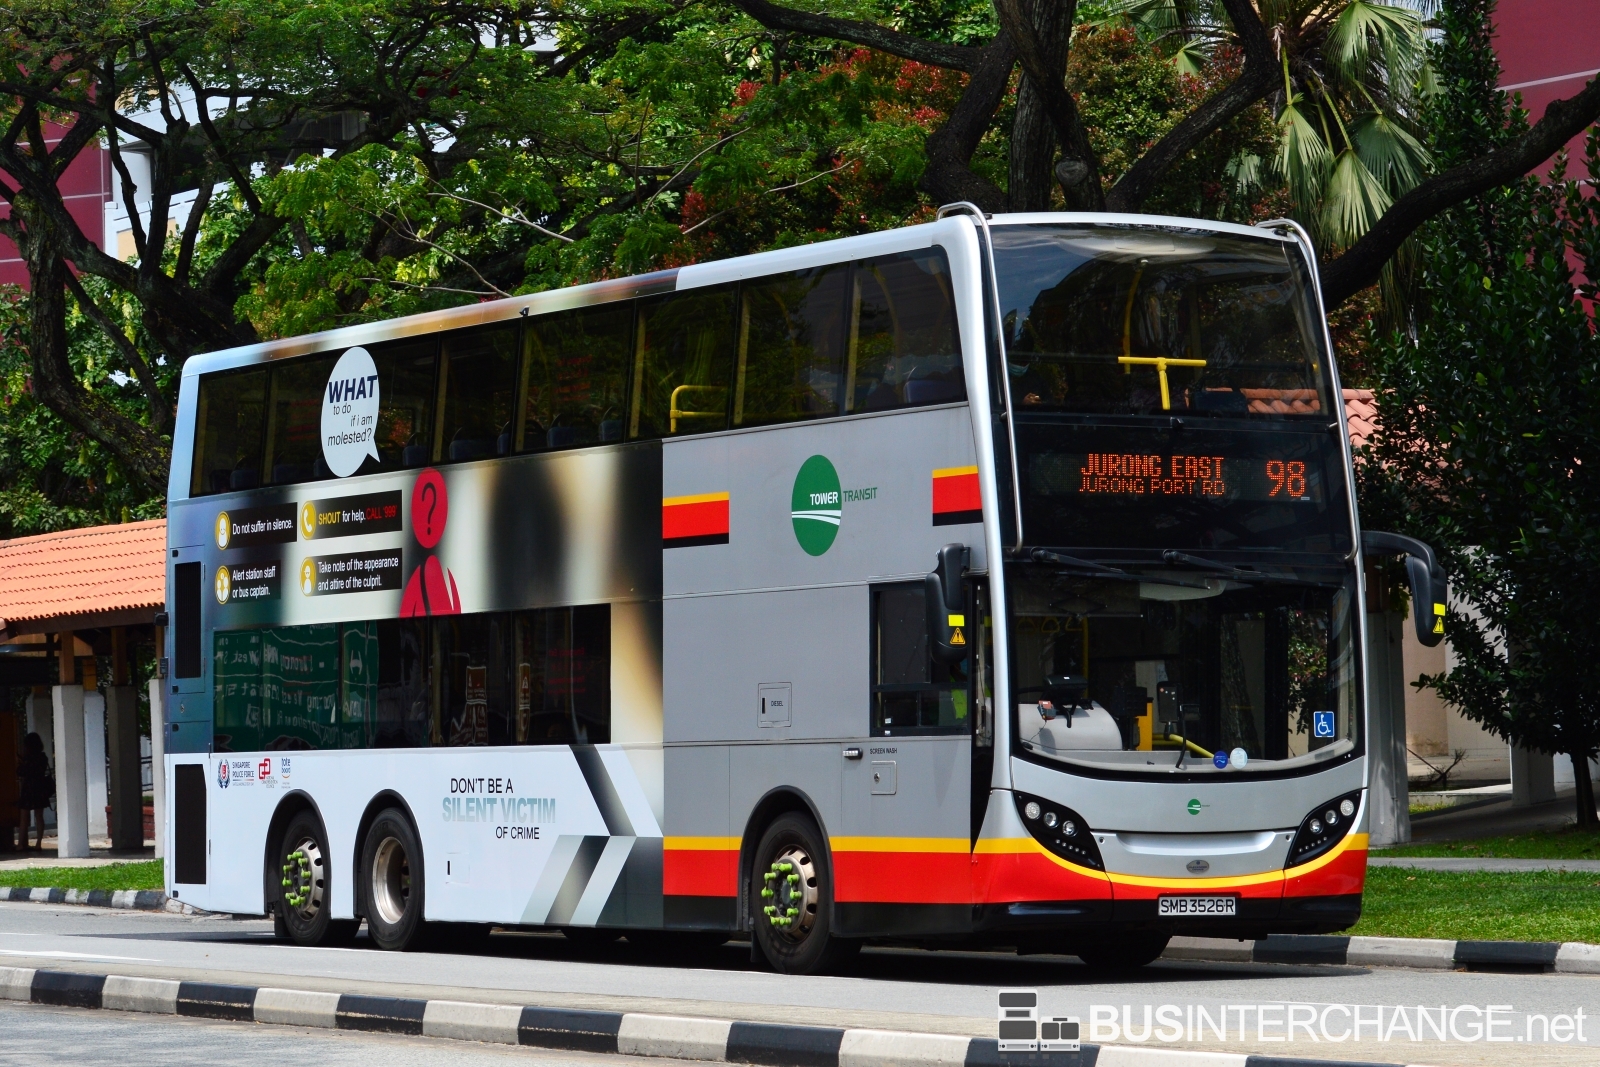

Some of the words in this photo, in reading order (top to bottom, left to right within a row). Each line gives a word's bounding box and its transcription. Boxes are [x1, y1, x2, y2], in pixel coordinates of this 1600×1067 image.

[328, 374, 378, 404] WHAT
[333, 404, 340, 416] to
[341, 402, 352, 414] do
[350, 415, 356, 427] if
[360, 415, 373, 426] am
[327, 427, 372, 447] molested?
[1081, 453, 1162, 477] JURONG
[1171, 455, 1225, 478] EAST
[1079, 477, 1145, 493] JURONG
[1150, 478, 1196, 494] PORT
[1202, 480, 1225, 495] RD
[1266, 460, 1305, 497] 98
[809, 491, 839, 506] TOWER
[843, 487, 878, 502] TRANSIT
[318, 511, 341, 526] SHOUT
[342, 510, 351, 523] for
[352, 508, 366, 524] help.
[366, 506, 382, 520] CALL
[232, 523, 241, 535] Do
[241, 520, 250, 534] not
[250, 520, 266, 532] suffer
[266, 520, 272, 530] in
[272, 518, 294, 529] silence.
[232, 569, 245, 582] Alert
[246, 567, 264, 580] station
[264, 566, 276, 578] staff
[318, 561, 332, 574] Take
[332, 560, 346, 573] note
[346, 558, 354, 572] of
[354, 558, 363, 571] the
[364, 556, 399, 572] appearance
[232, 588, 239, 599] or
[239, 586, 250, 598] bus
[250, 584, 271, 599] captain.
[318, 579, 329, 592] and
[329, 578, 344, 590] attire
[345, 576, 352, 589] of
[352, 576, 362, 588] the
[362, 574, 382, 590] culprit.
[450, 778, 484, 794] DON'T
[488, 778, 502, 794] BE
[505, 778, 514, 794] A
[442, 796, 498, 822] SILENT
[500, 798, 556, 824] VICTIM
[496, 826, 508, 839] OF
[510, 827, 540, 840] CRIME
[1160, 899, 1234, 913] SMB3526R
